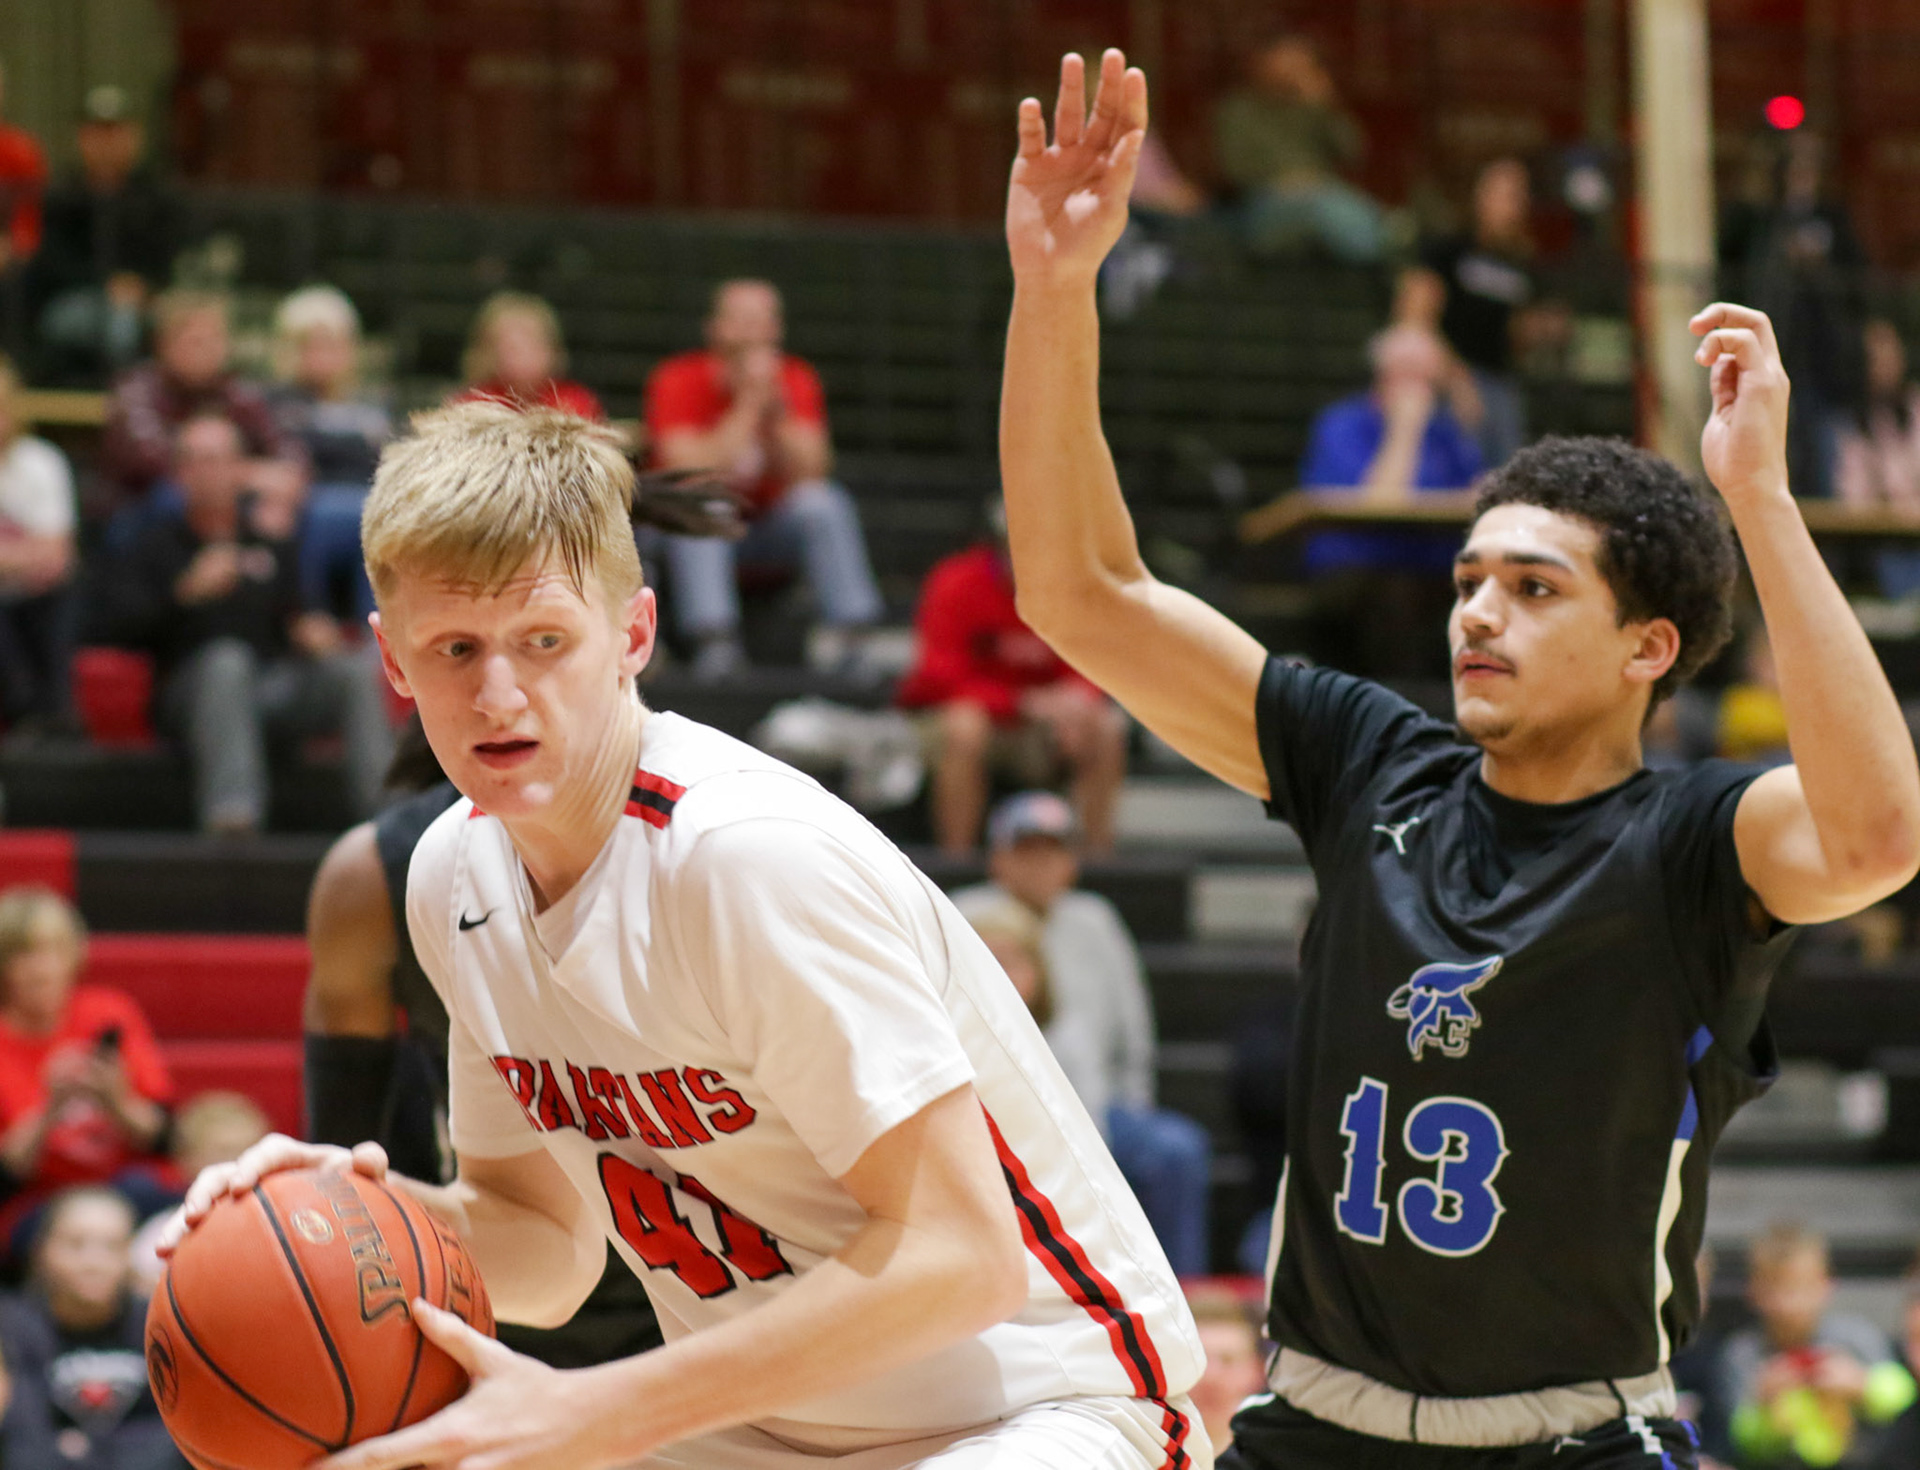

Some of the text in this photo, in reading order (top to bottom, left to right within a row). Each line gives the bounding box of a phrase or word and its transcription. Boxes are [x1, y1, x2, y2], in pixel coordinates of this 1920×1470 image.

[488, 1055, 757, 1149] PARTANS
[1334, 1076, 1511, 1257] 13
[597, 1151, 795, 1300] 41
